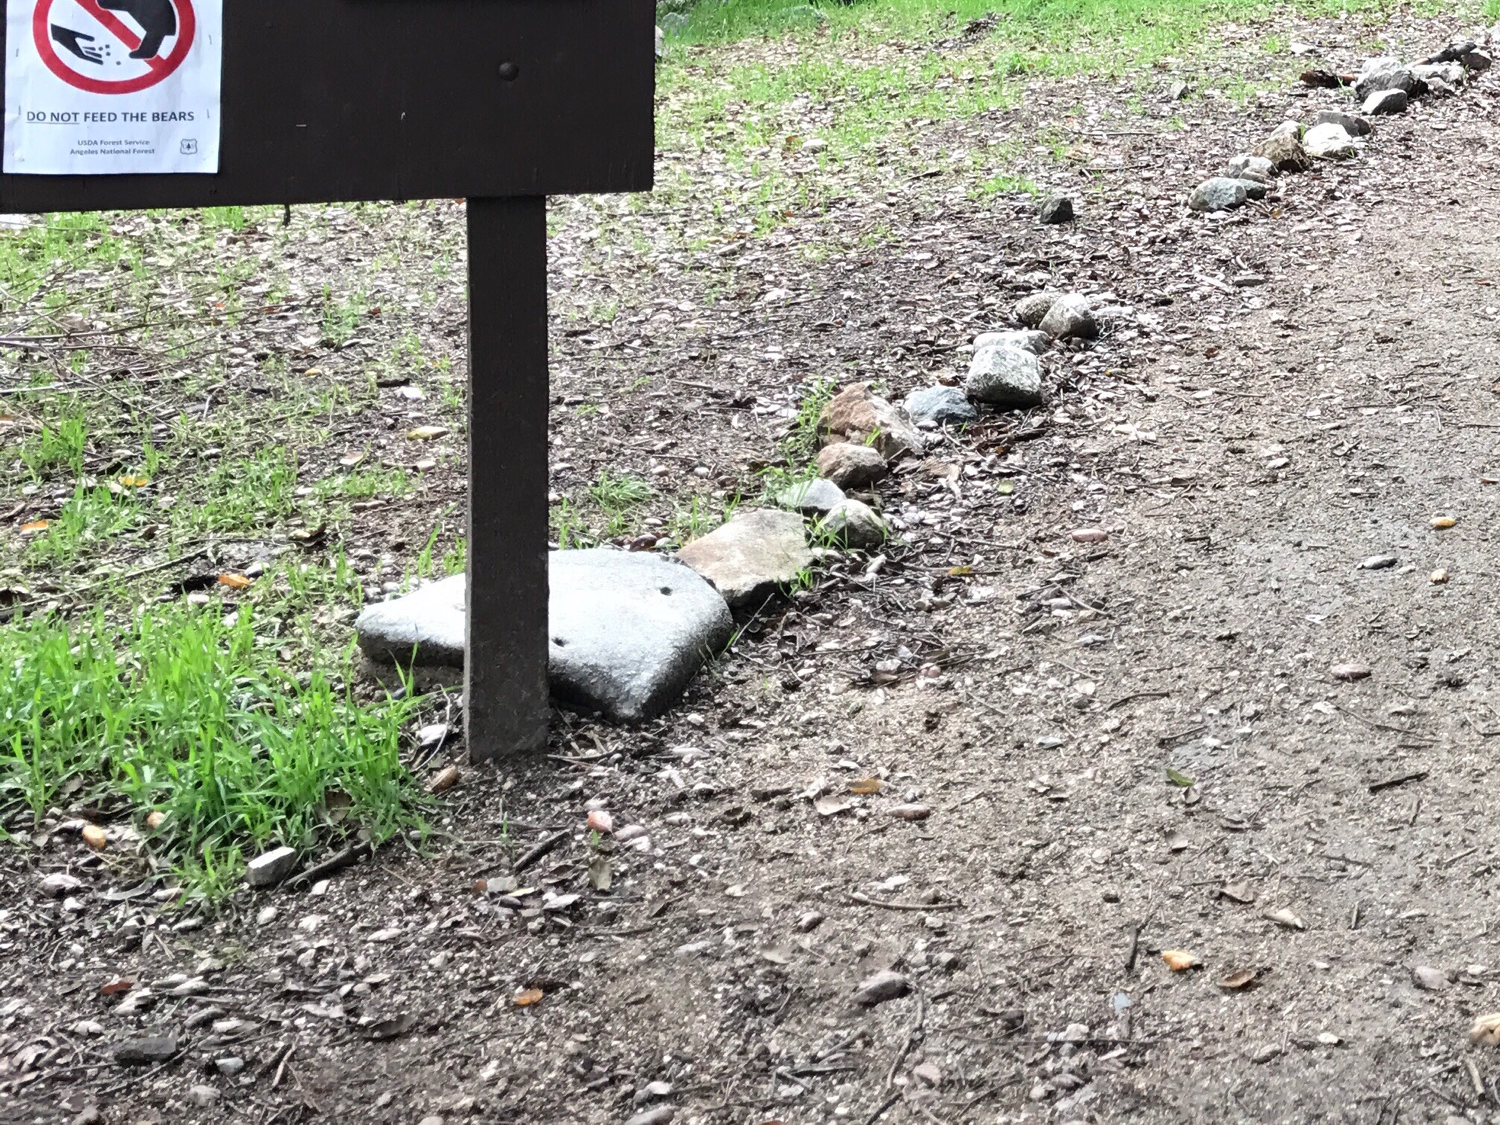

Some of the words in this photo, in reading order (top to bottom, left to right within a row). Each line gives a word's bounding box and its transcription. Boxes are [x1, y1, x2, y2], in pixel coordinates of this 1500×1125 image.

[26, 111, 46, 122] DO
[50, 112, 80, 123] NOT
[83, 112, 117, 123] FEED
[121, 112, 147, 122] THE
[152, 111, 195, 122] BEARS
[70, 148, 98, 156] Angeles
